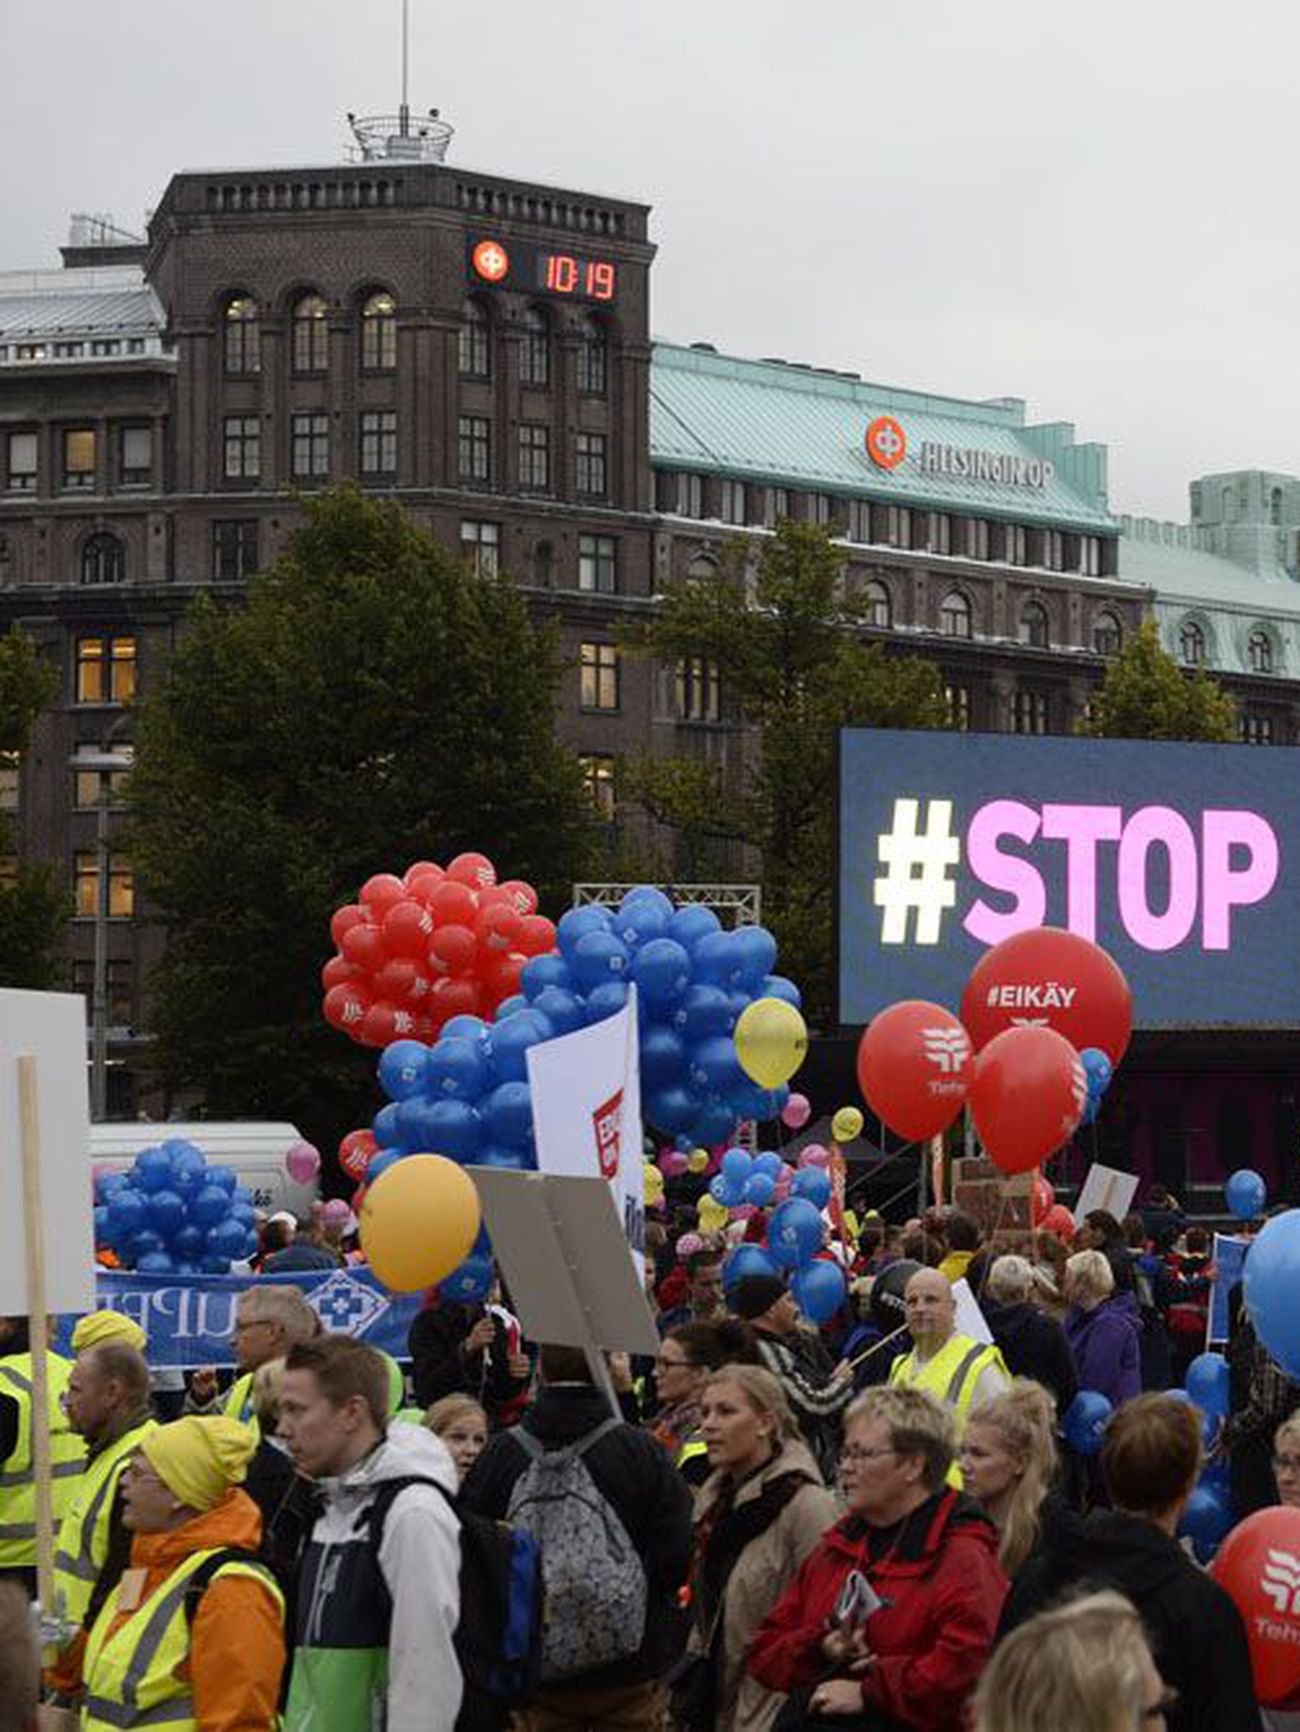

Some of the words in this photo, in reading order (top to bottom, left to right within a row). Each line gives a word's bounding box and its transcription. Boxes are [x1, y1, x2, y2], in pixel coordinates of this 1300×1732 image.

[1027, 459, 1054, 488] OP
[873, 798, 1280, 952] #STOP
[987, 981, 1077, 1008] #EIKÄY
